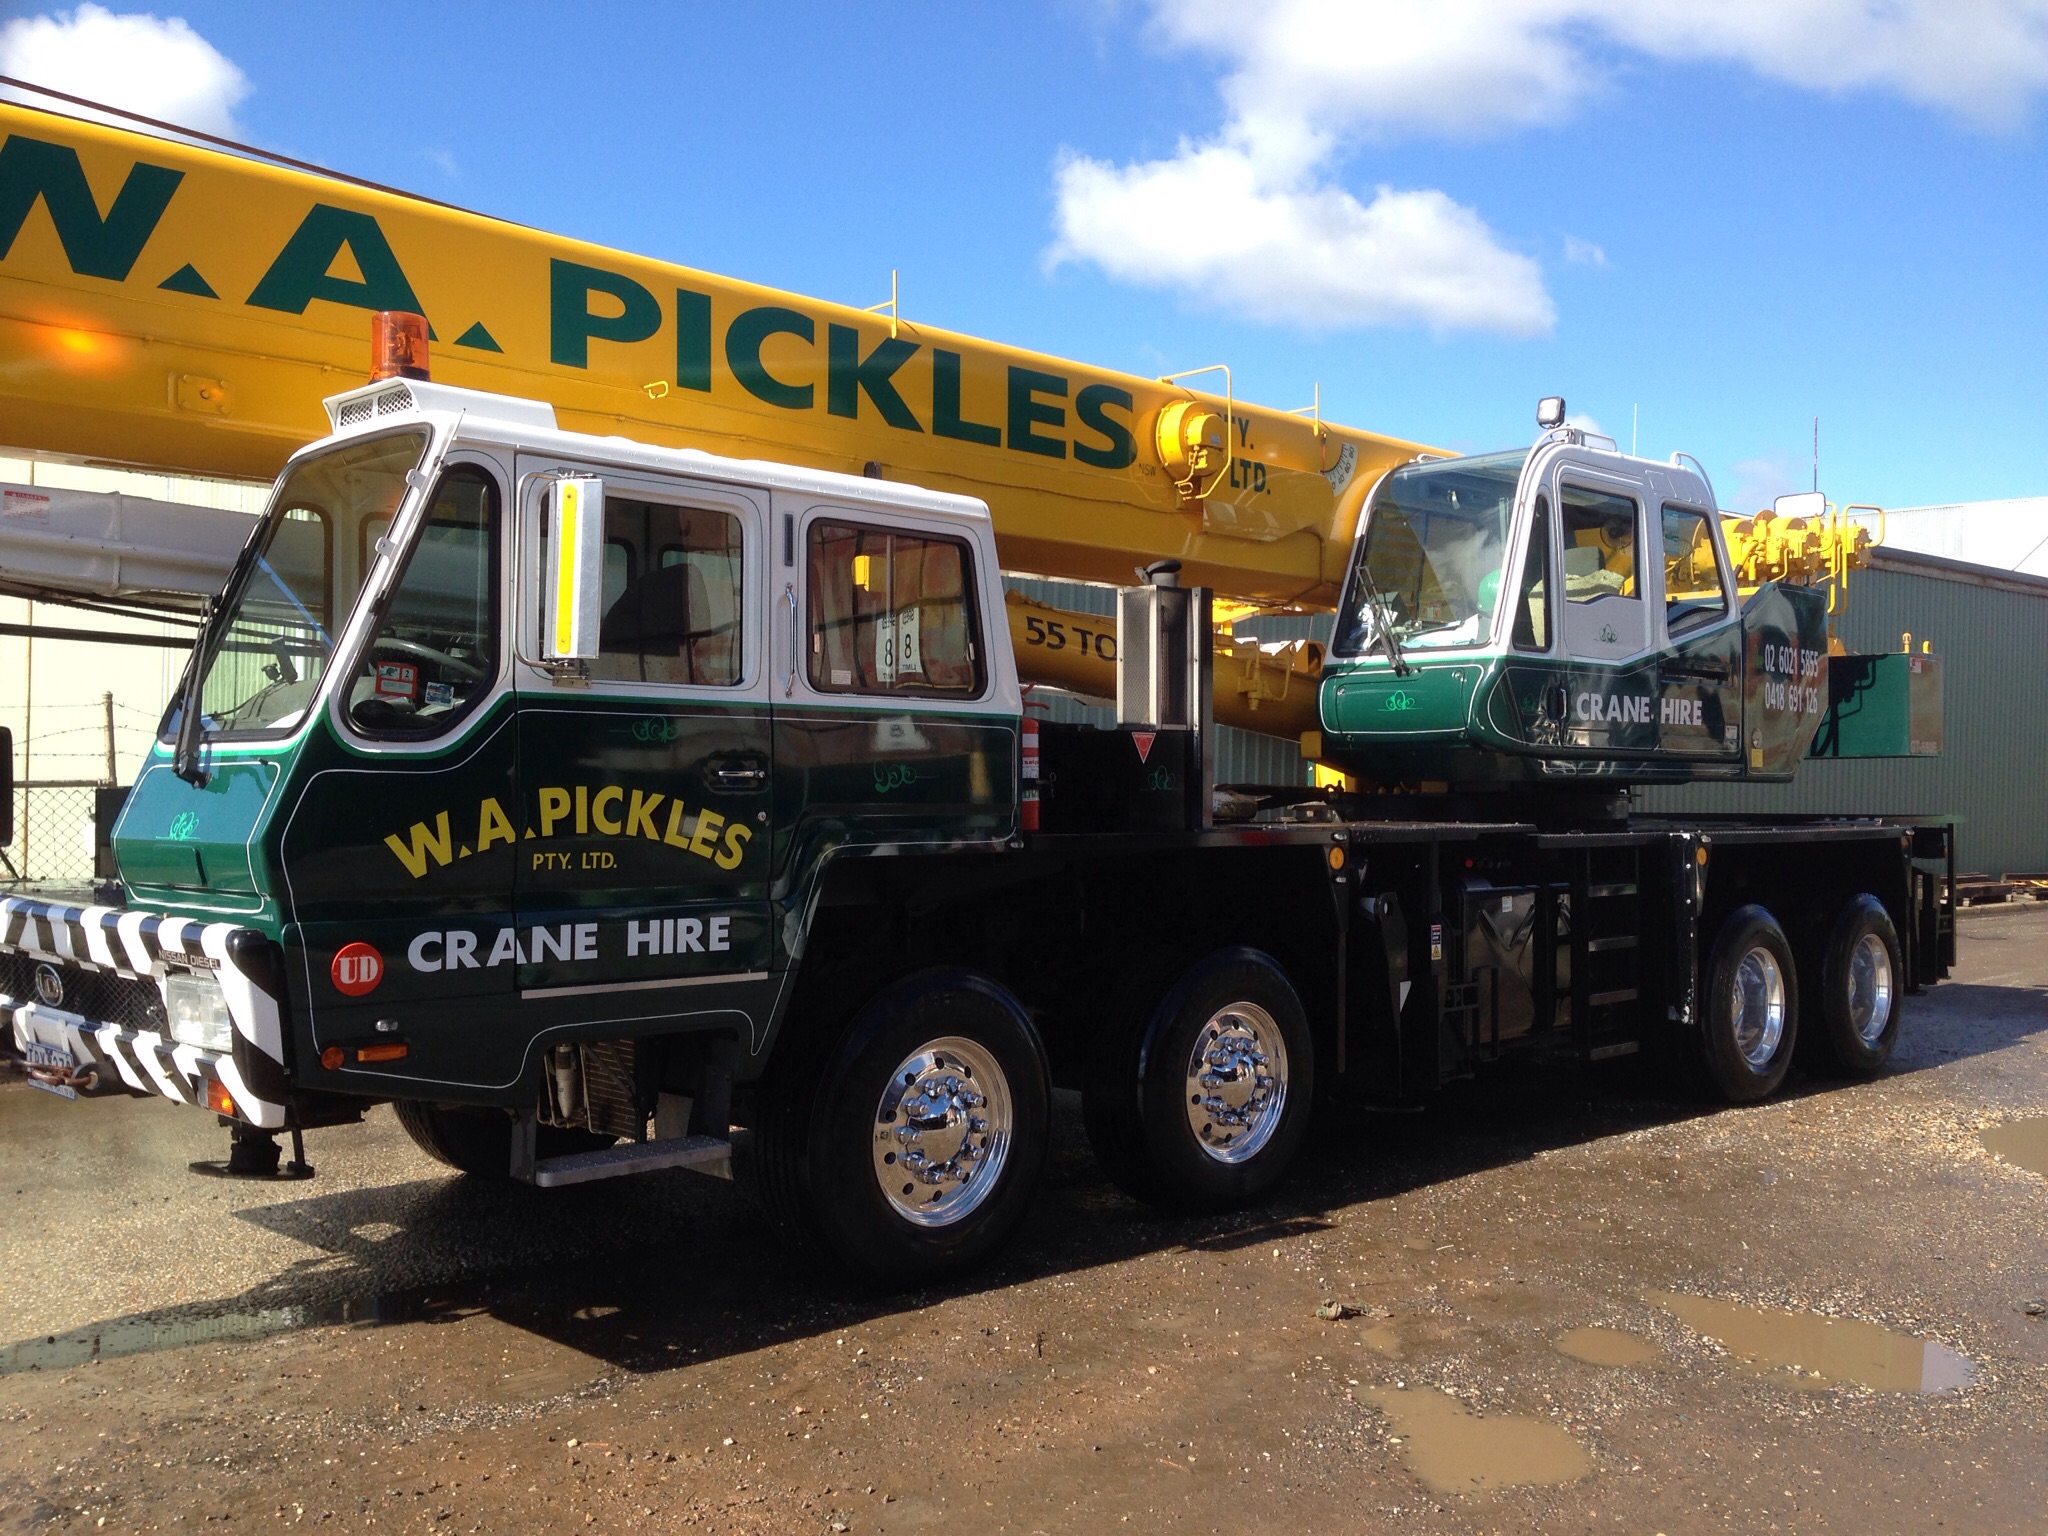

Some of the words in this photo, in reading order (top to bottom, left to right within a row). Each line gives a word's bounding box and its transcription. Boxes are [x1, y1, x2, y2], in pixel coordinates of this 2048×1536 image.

[550, 258, 1138, 469] PICKLES
[1230, 457, 1271, 495] LTD.
[1025, 615, 1067, 650] 55
[1764, 643, 1776, 672] 02
[1778, 645, 1799, 675] 6021
[1800, 648, 1819, 678] 5855
[1576, 692, 1651, 723] CRANE
[1660, 698, 1703, 726] HIRE
[1764, 681, 1785, 711] 0418
[1788, 684, 1802, 712] 691
[1805, 686, 1818, 714] 126
[538, 785, 753, 871] PICKLES
[532, 853, 572, 870] PTY.
[581, 851, 618, 869] LTD.
[158, 949, 189, 965] NISSAN
[189, 954, 221, 971] DIESEL
[407, 922, 599, 973] CRANE
[626, 915, 732, 957] HIRE
[338, 955, 379, 984] UD
